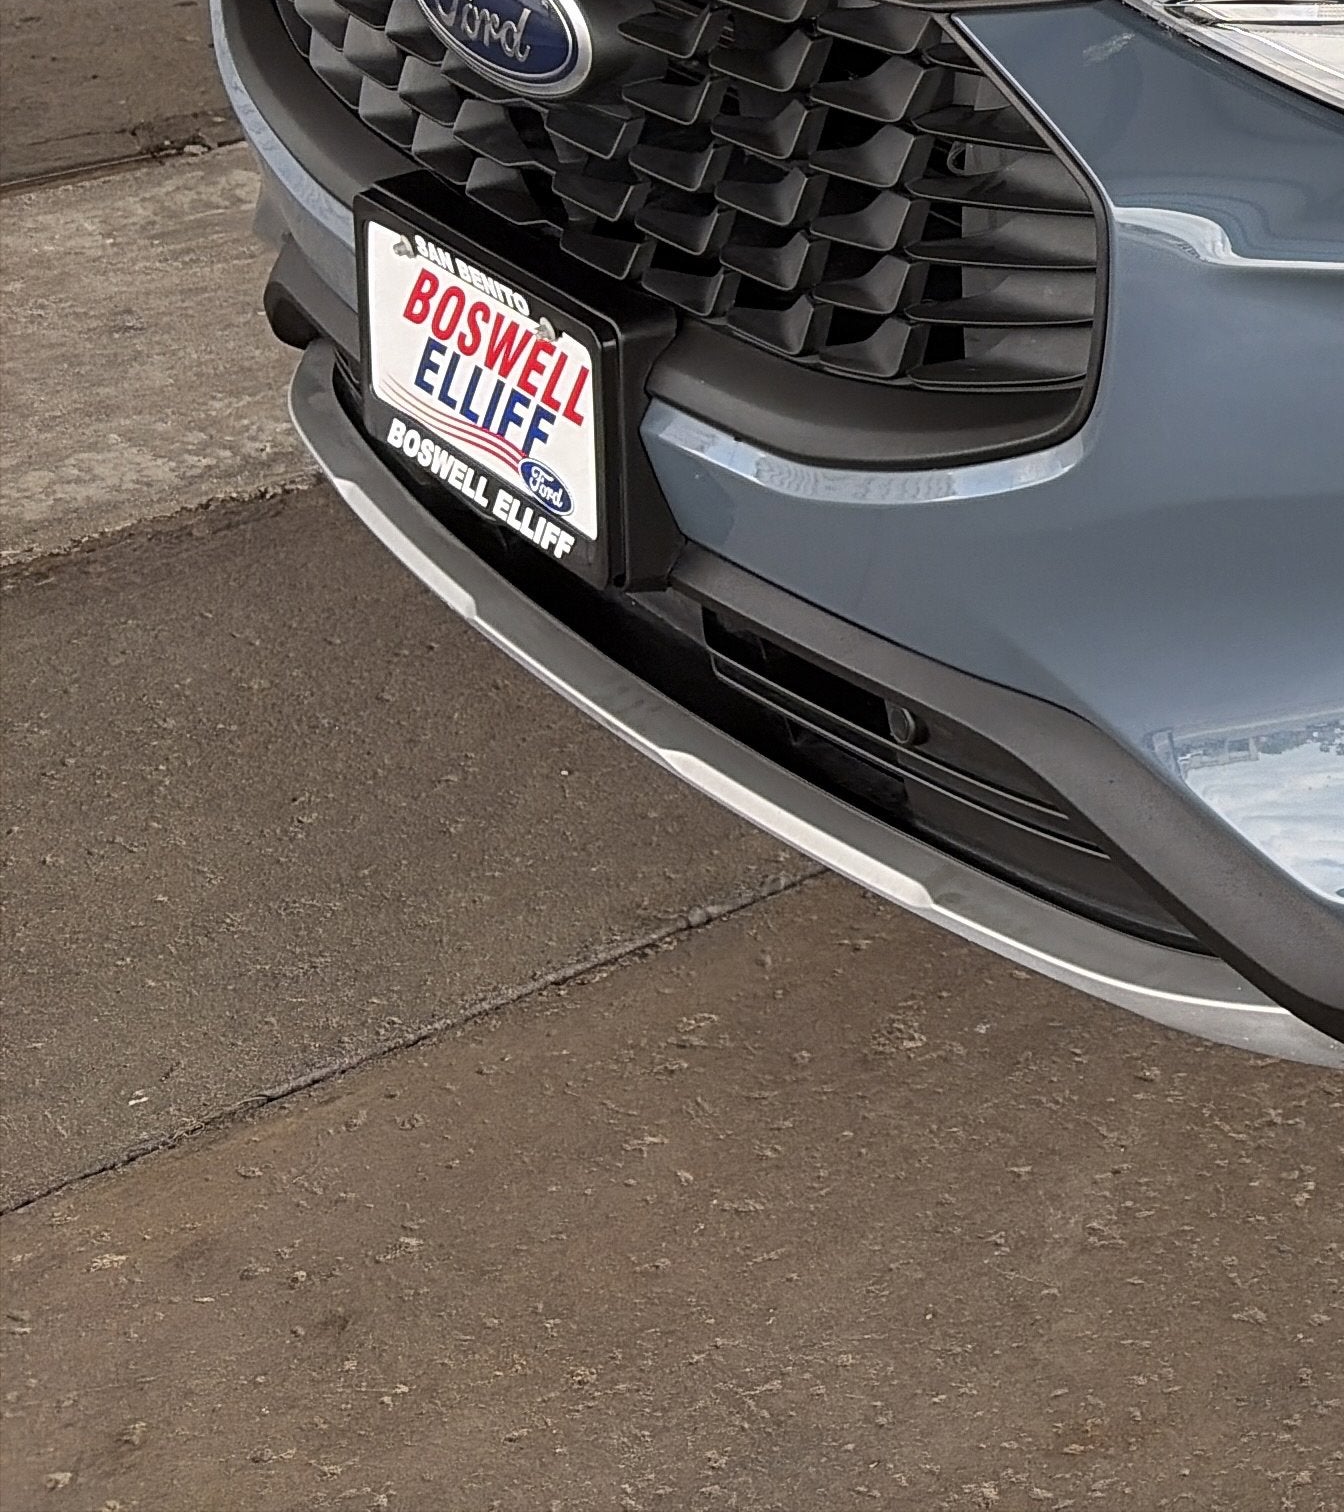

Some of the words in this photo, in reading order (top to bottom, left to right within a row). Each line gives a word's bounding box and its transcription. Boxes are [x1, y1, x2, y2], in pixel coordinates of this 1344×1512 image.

[415, 235, 455, 275] SAN
[456, 257, 530, 316] BENITO
[404, 268, 590, 426] BOSWELL
[414, 337, 556, 454] ELLIFF
[387, 418, 490, 507] BOSWELL
[493, 493, 574, 559] ELLIFF
[525, 465, 564, 508] Ford
